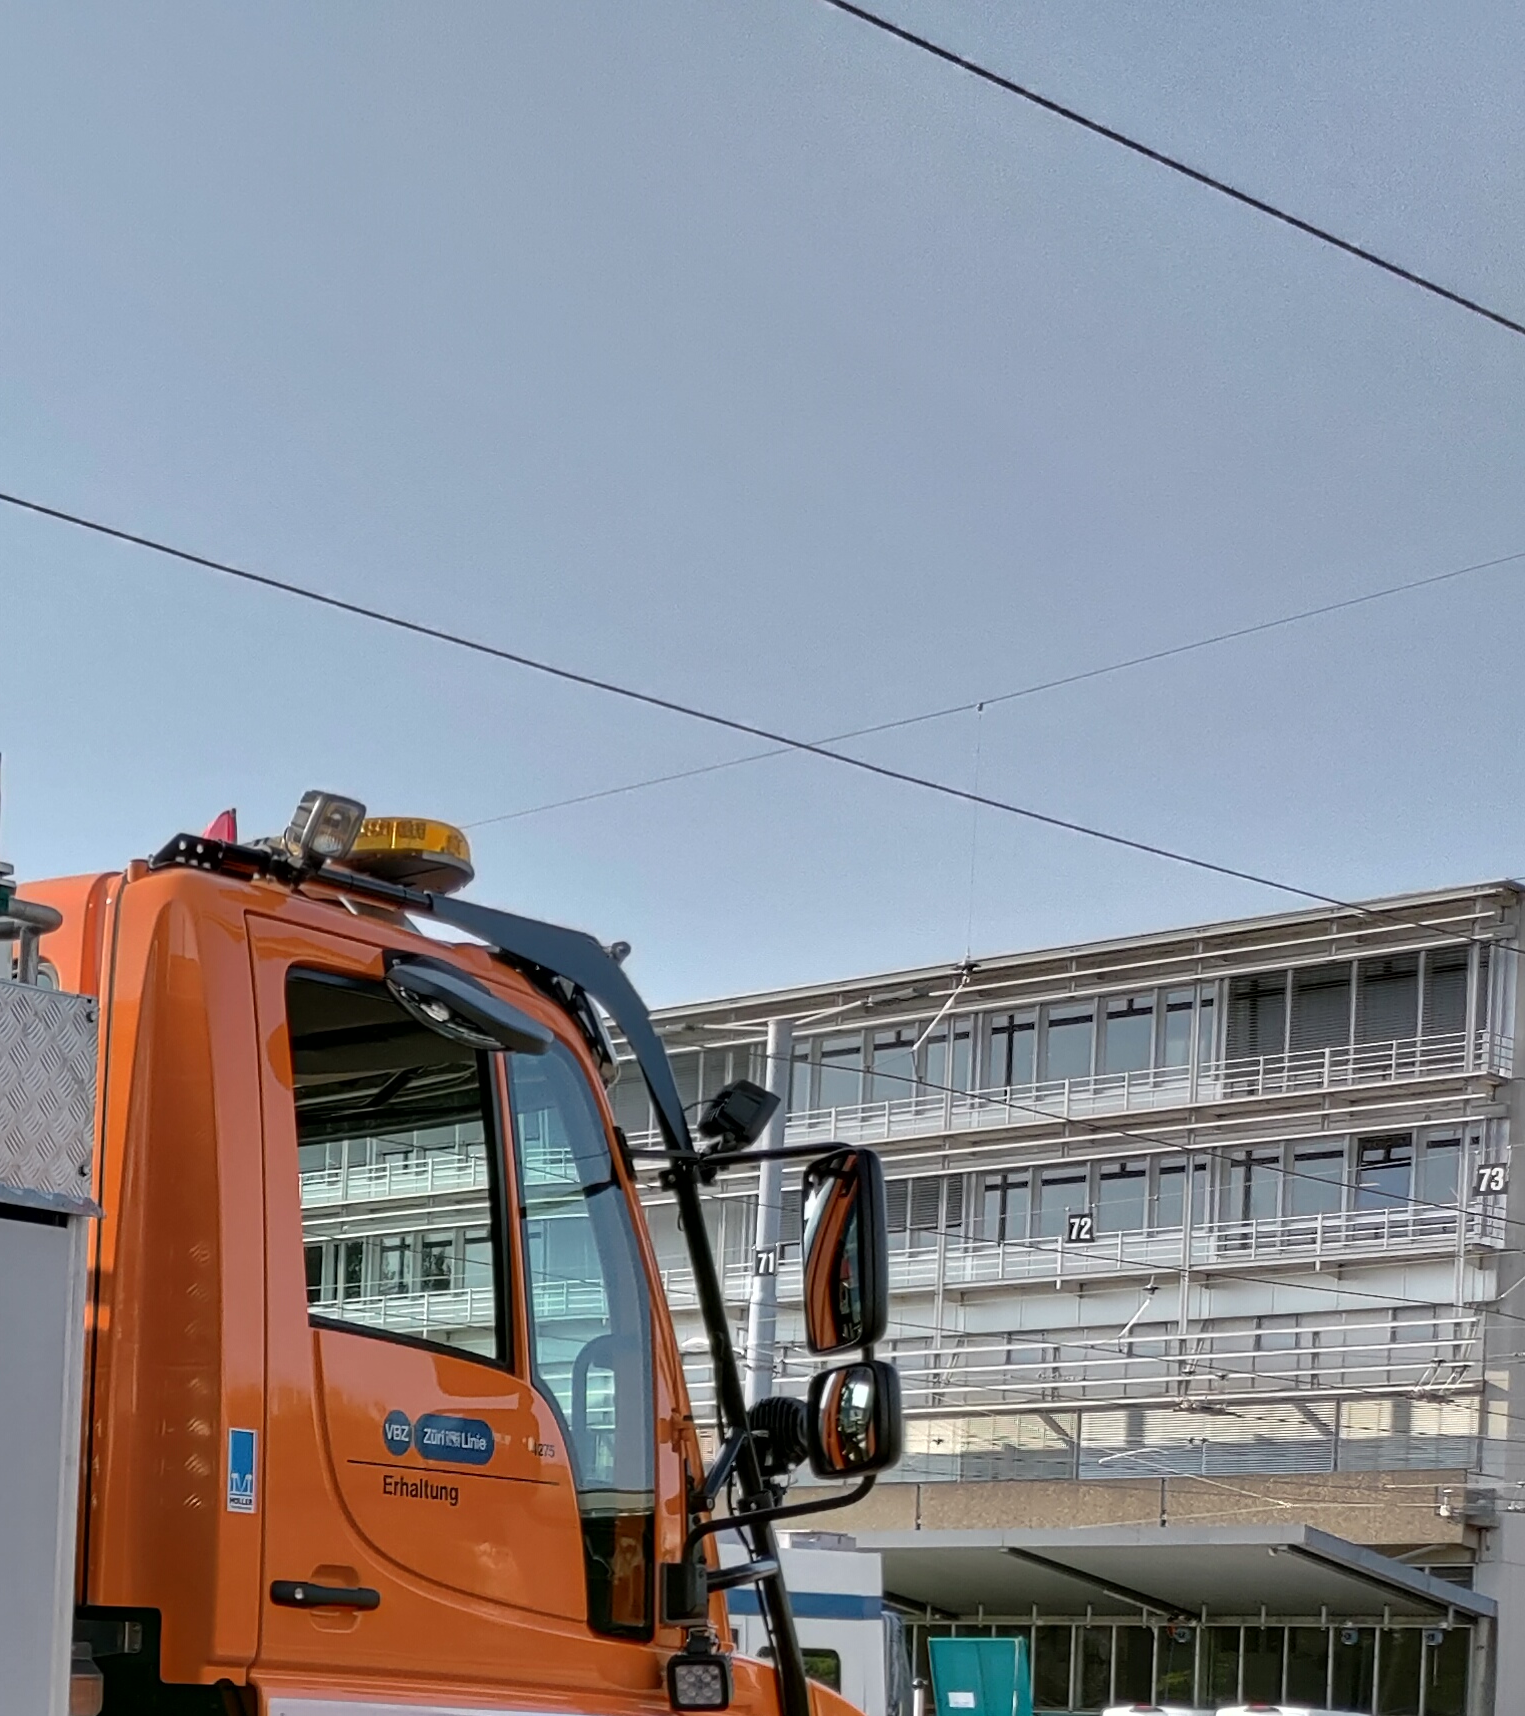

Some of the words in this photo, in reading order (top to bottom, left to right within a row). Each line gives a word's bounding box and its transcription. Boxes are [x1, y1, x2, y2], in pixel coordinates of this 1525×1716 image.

[1479, 1167, 1504, 1192] 73
[1069, 1217, 1092, 1240] 72
[757, 1252, 775, 1274] 71
[385, 1423, 410, 1442] VBZ
[382, 1475, 459, 1507] Erhaltung
